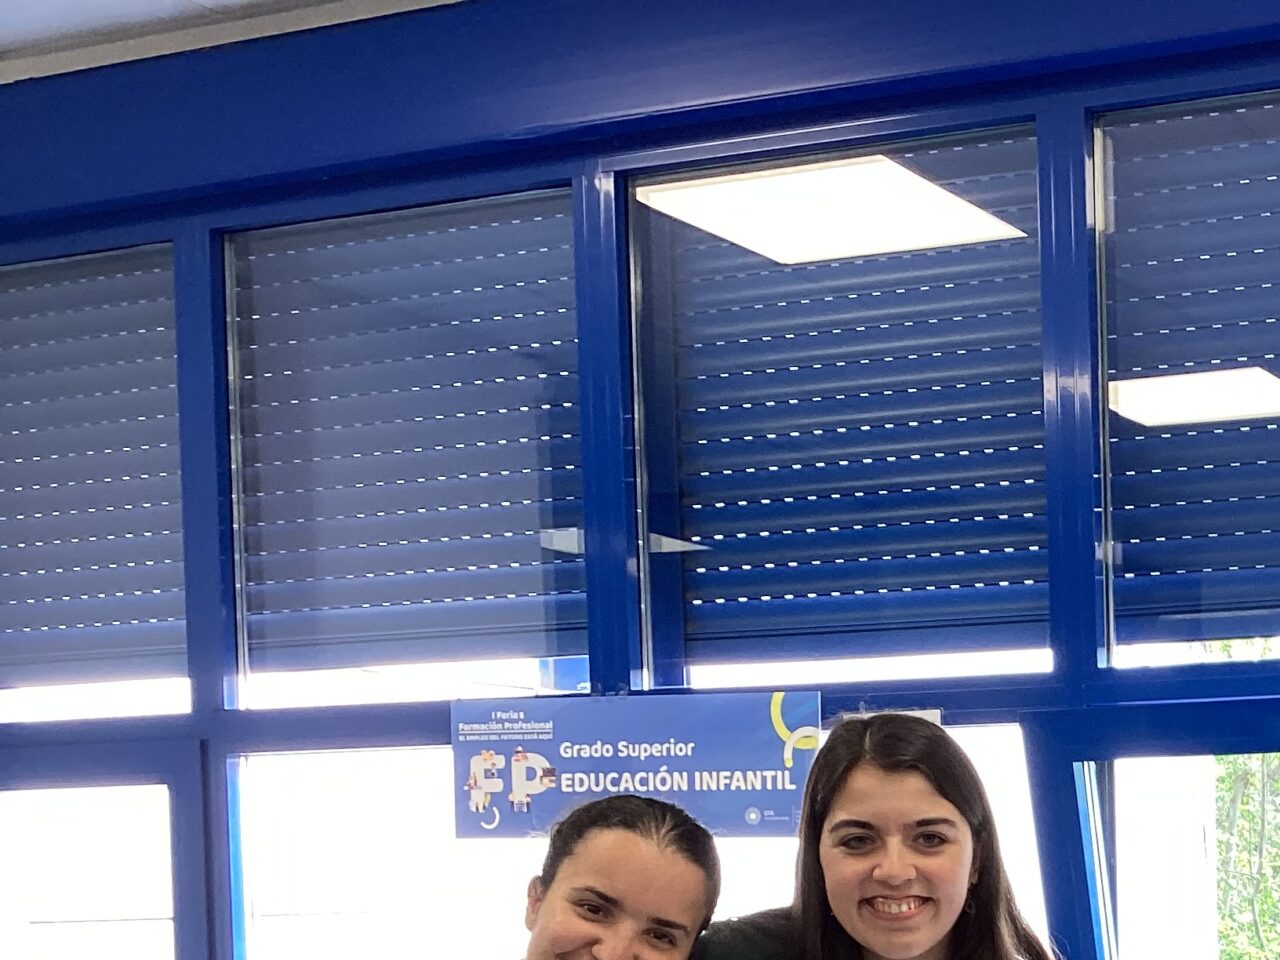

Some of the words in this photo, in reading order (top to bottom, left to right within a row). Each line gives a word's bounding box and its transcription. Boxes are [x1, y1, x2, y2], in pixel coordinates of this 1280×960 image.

[458, 721, 503, 731] Formación
[504, 720, 553, 730] Profesional
[559, 741, 612, 758] Grado
[617, 740, 695, 759] Superior
[561, 767, 686, 793] EDUCACIÓN
[695, 770, 796, 792] INFANTIL
